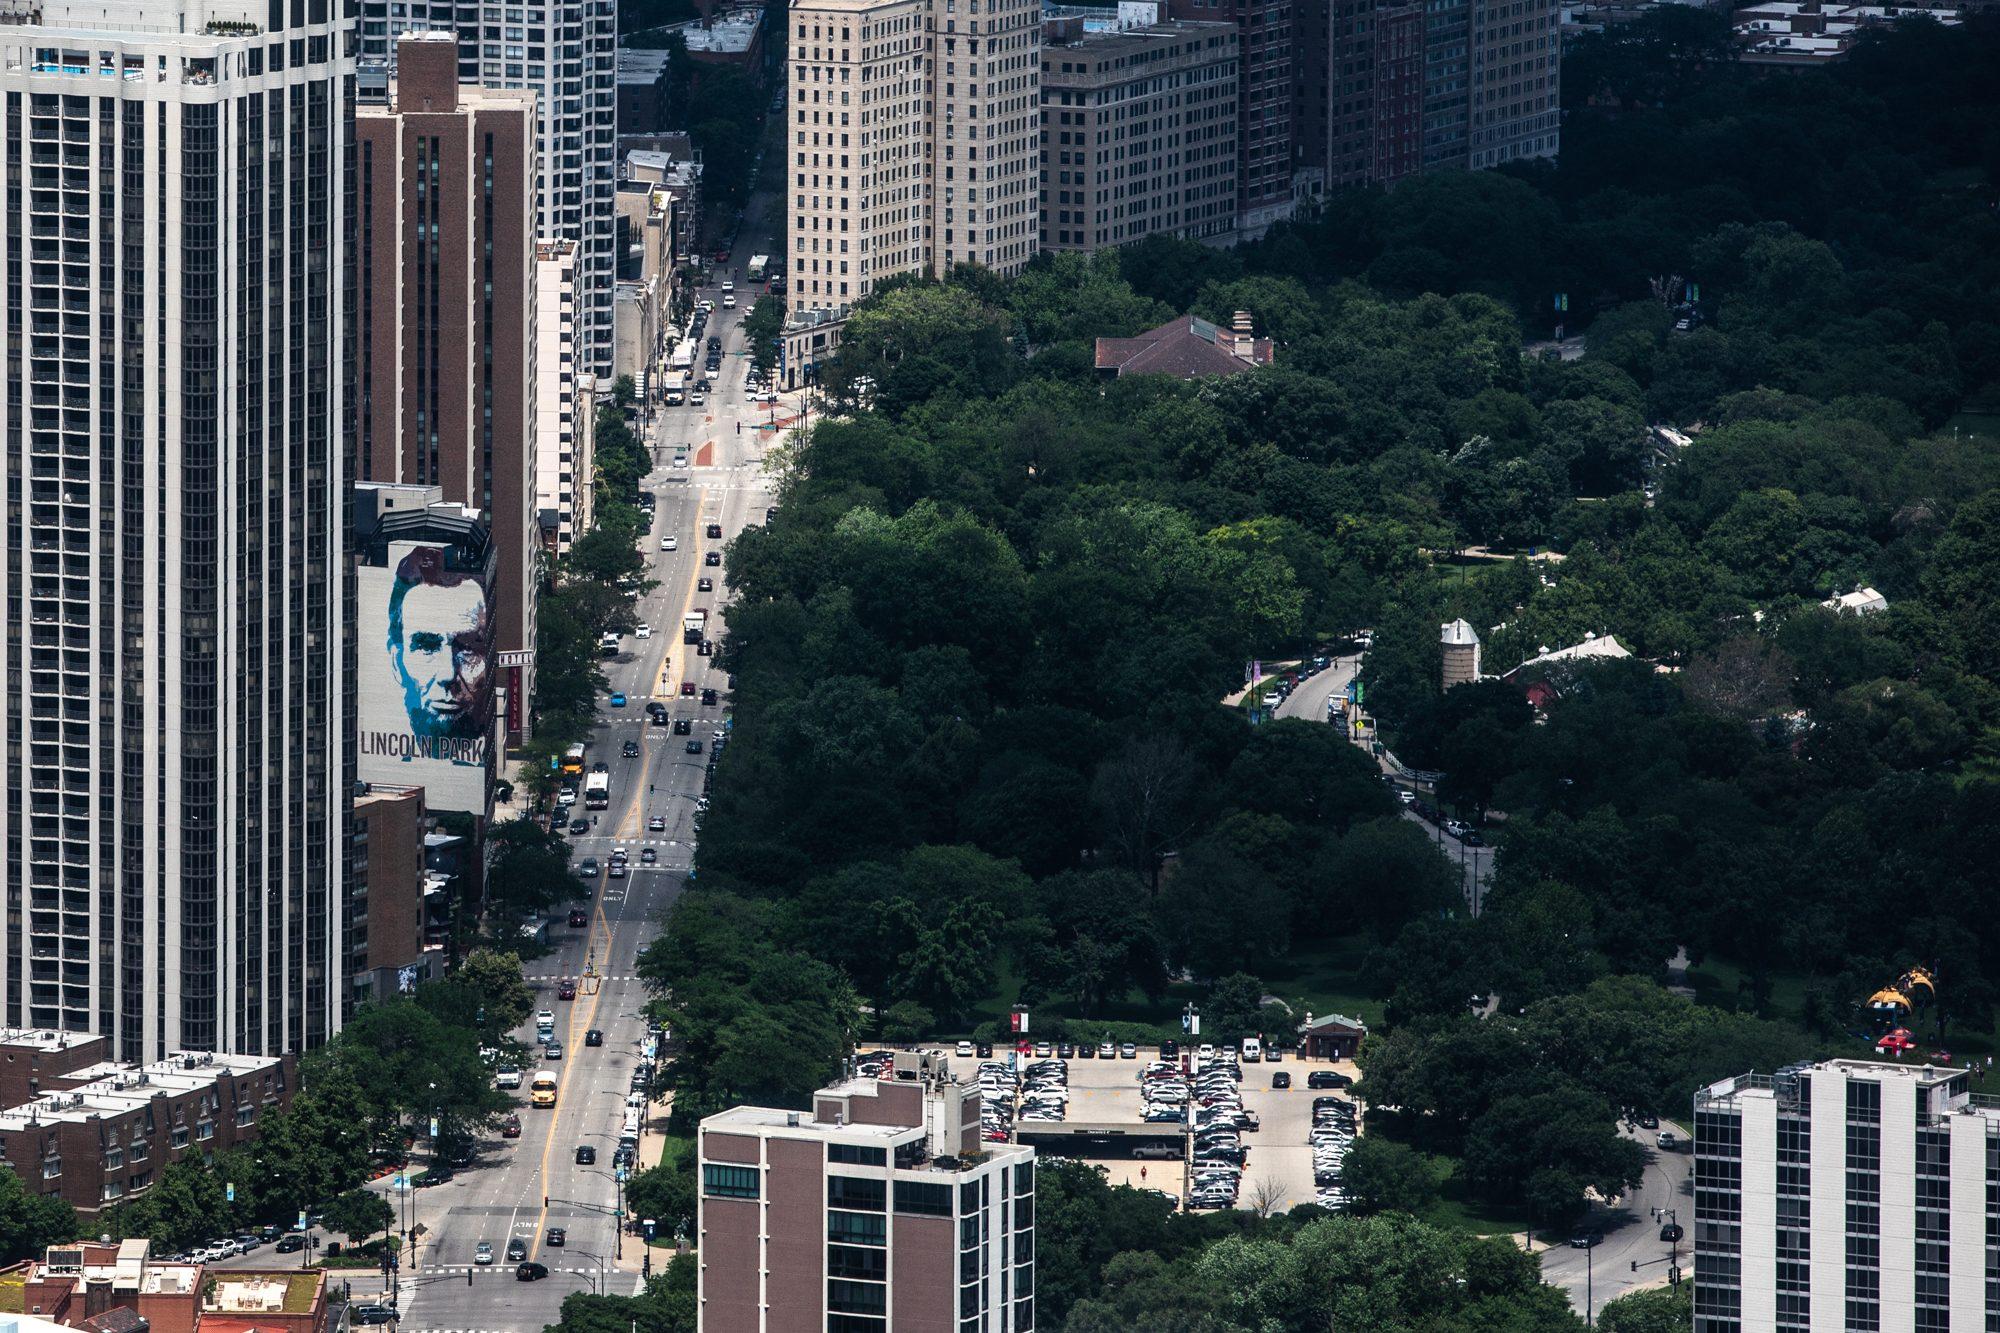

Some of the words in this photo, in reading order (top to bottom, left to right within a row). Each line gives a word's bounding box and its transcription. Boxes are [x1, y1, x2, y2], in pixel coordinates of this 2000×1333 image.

[500, 654, 532, 664] HOTEL
[361, 731, 433, 759] LINCOLN
[438, 736, 484, 762] PARK
